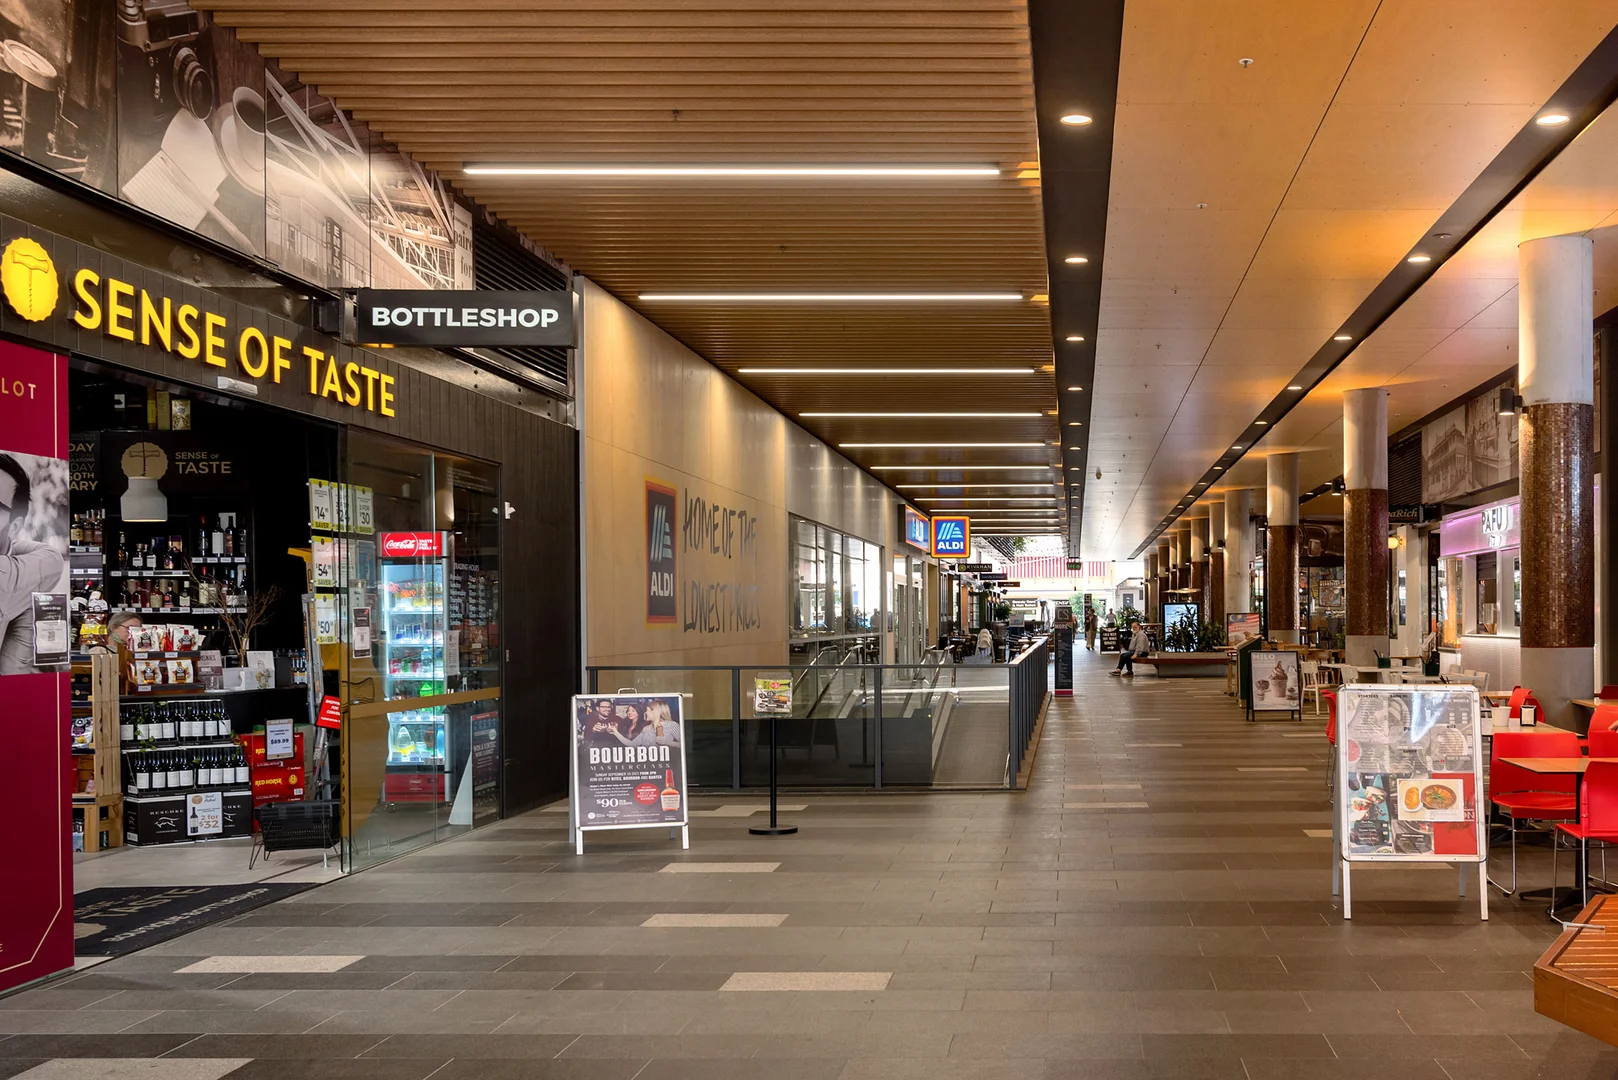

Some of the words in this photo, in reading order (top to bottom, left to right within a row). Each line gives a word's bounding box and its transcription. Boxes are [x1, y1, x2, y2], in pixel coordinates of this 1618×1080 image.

[372, 307, 559, 328] BOTTLESHOP
[73, 268, 226, 368] SENSE
[239, 327, 292, 384] OF
[302, 346, 396, 418] TASTE
[175, 452, 208, 460] SENSE
[175, 462, 232, 474] TASTE
[683, 487, 720, 554] HOME
[722, 507, 736, 559] OF
[650, 571, 673, 597] ALDI
[590, 745, 670, 764] BOURBON
[596, 798, 618, 808] $90
[199, 820, 219, 829] $32
[80, 887, 212, 919] TASTE
